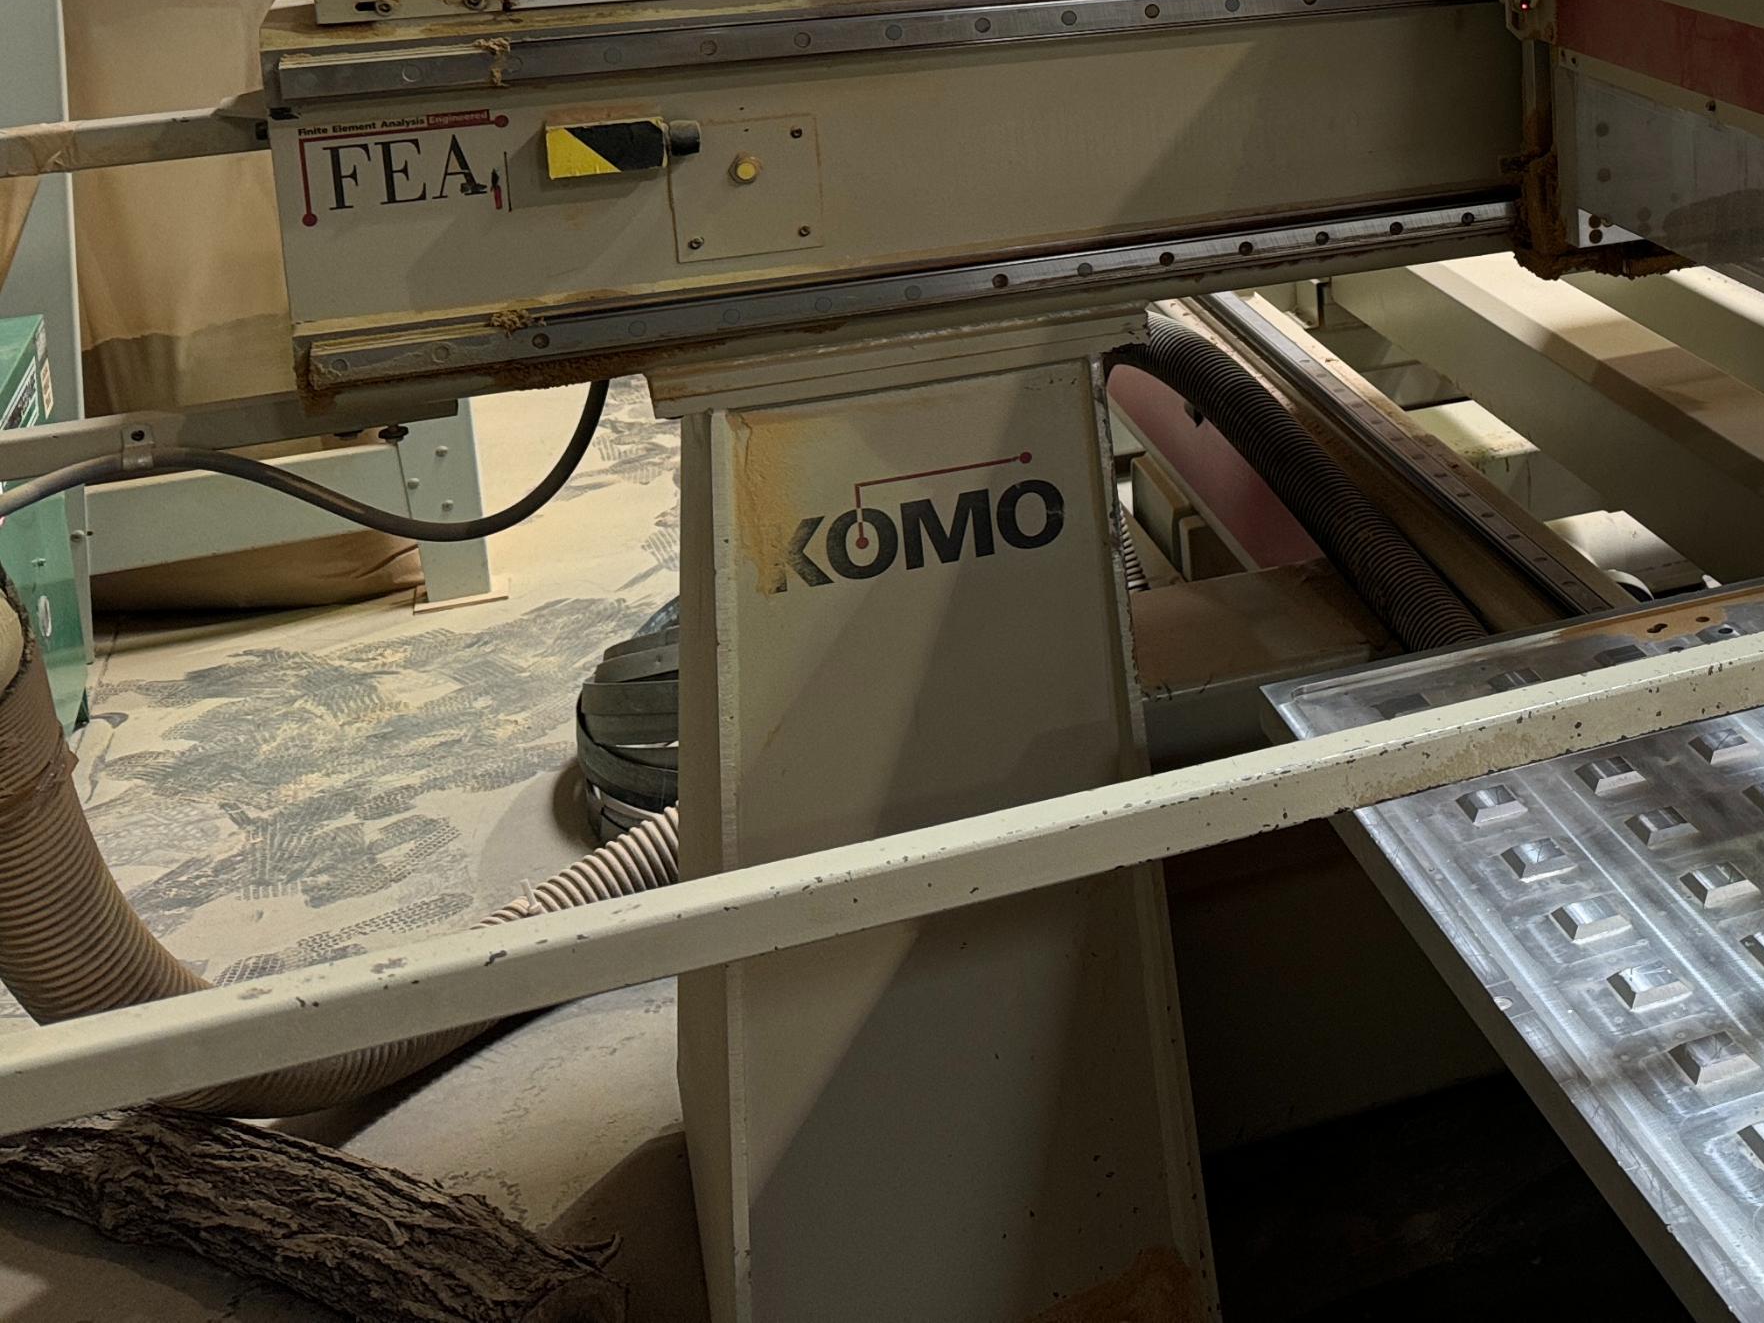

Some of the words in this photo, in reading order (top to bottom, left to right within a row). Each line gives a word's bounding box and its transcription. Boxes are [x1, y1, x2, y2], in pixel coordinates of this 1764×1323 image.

[298, 128, 329, 137] Finite
[332, 122, 377, 134] Element
[381, 117, 425, 129] Analysis
[428, 112, 488, 125] Engineered
[322, 134, 488, 211] FEA
[768, 479, 1065, 595] KOMO
